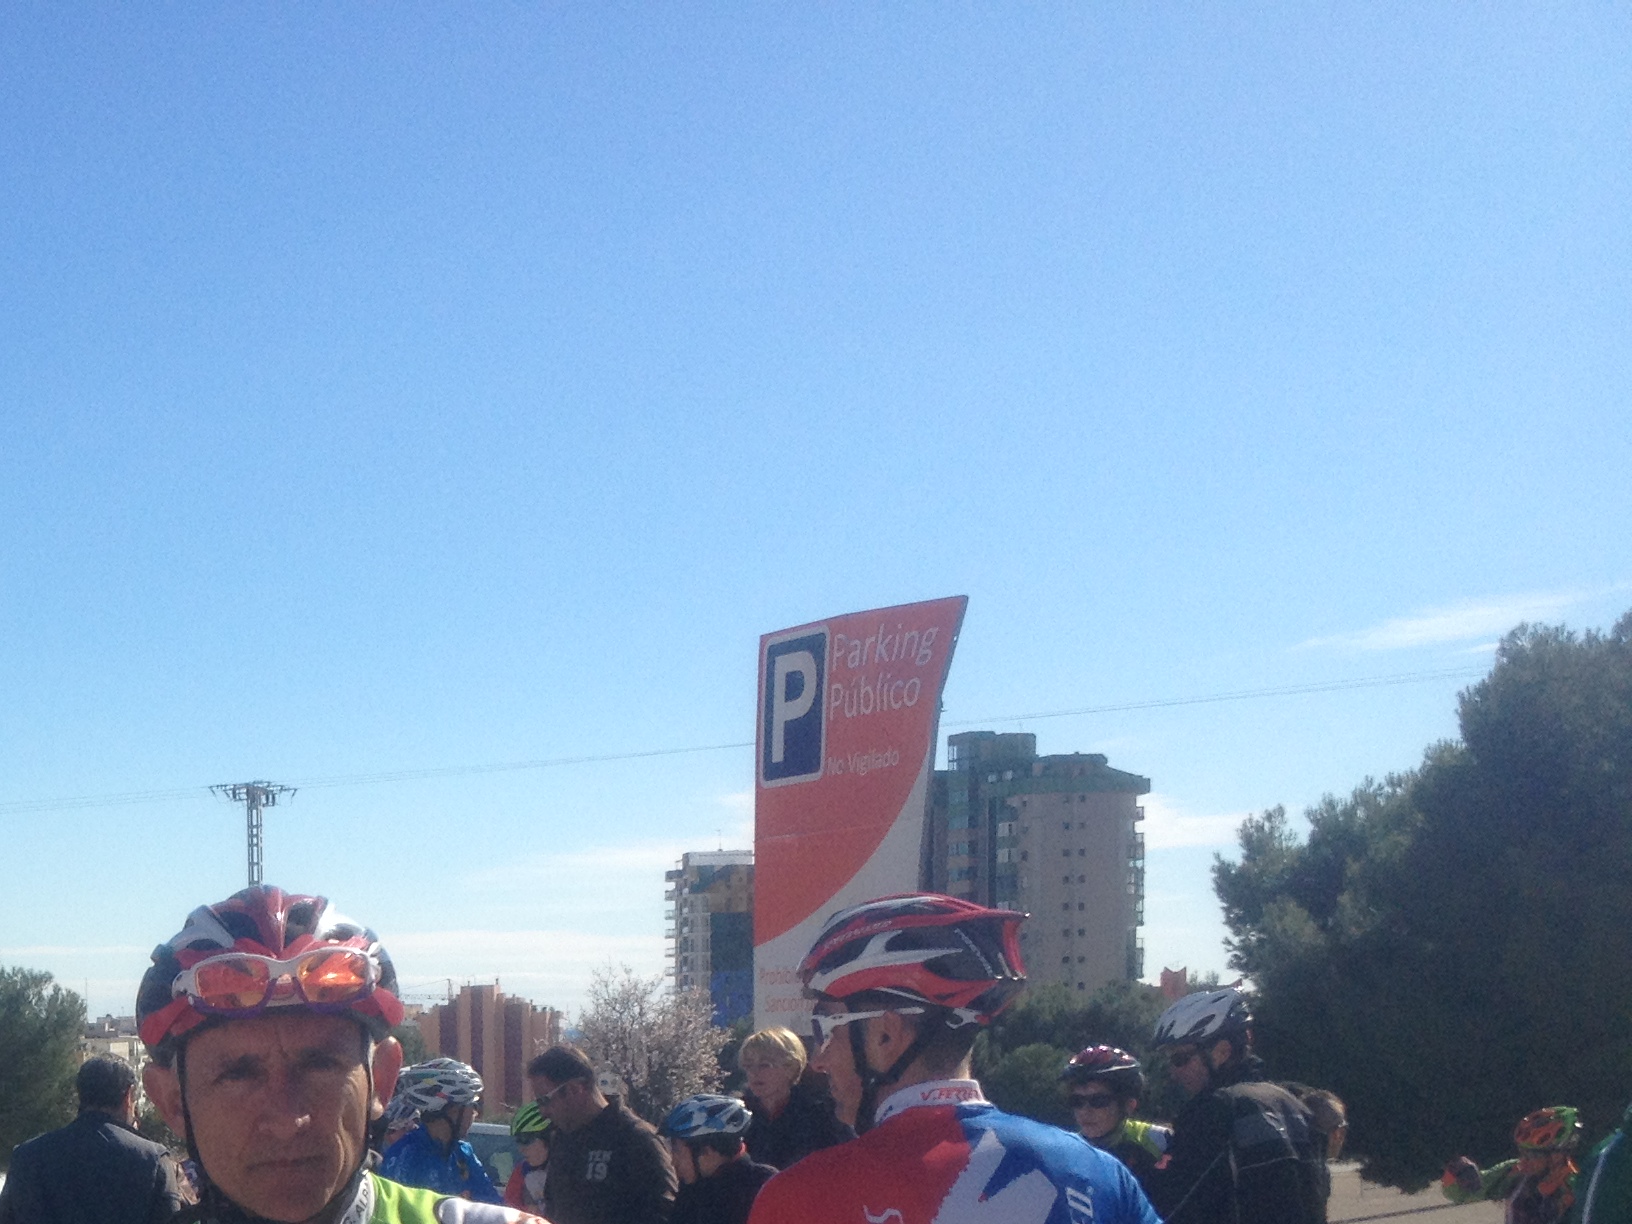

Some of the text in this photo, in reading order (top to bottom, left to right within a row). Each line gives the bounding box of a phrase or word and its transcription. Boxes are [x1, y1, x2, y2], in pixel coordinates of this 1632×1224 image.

[832, 623, 939, 671] Parking
[771, 650, 817, 764] P
[829, 673, 921, 720] Público
